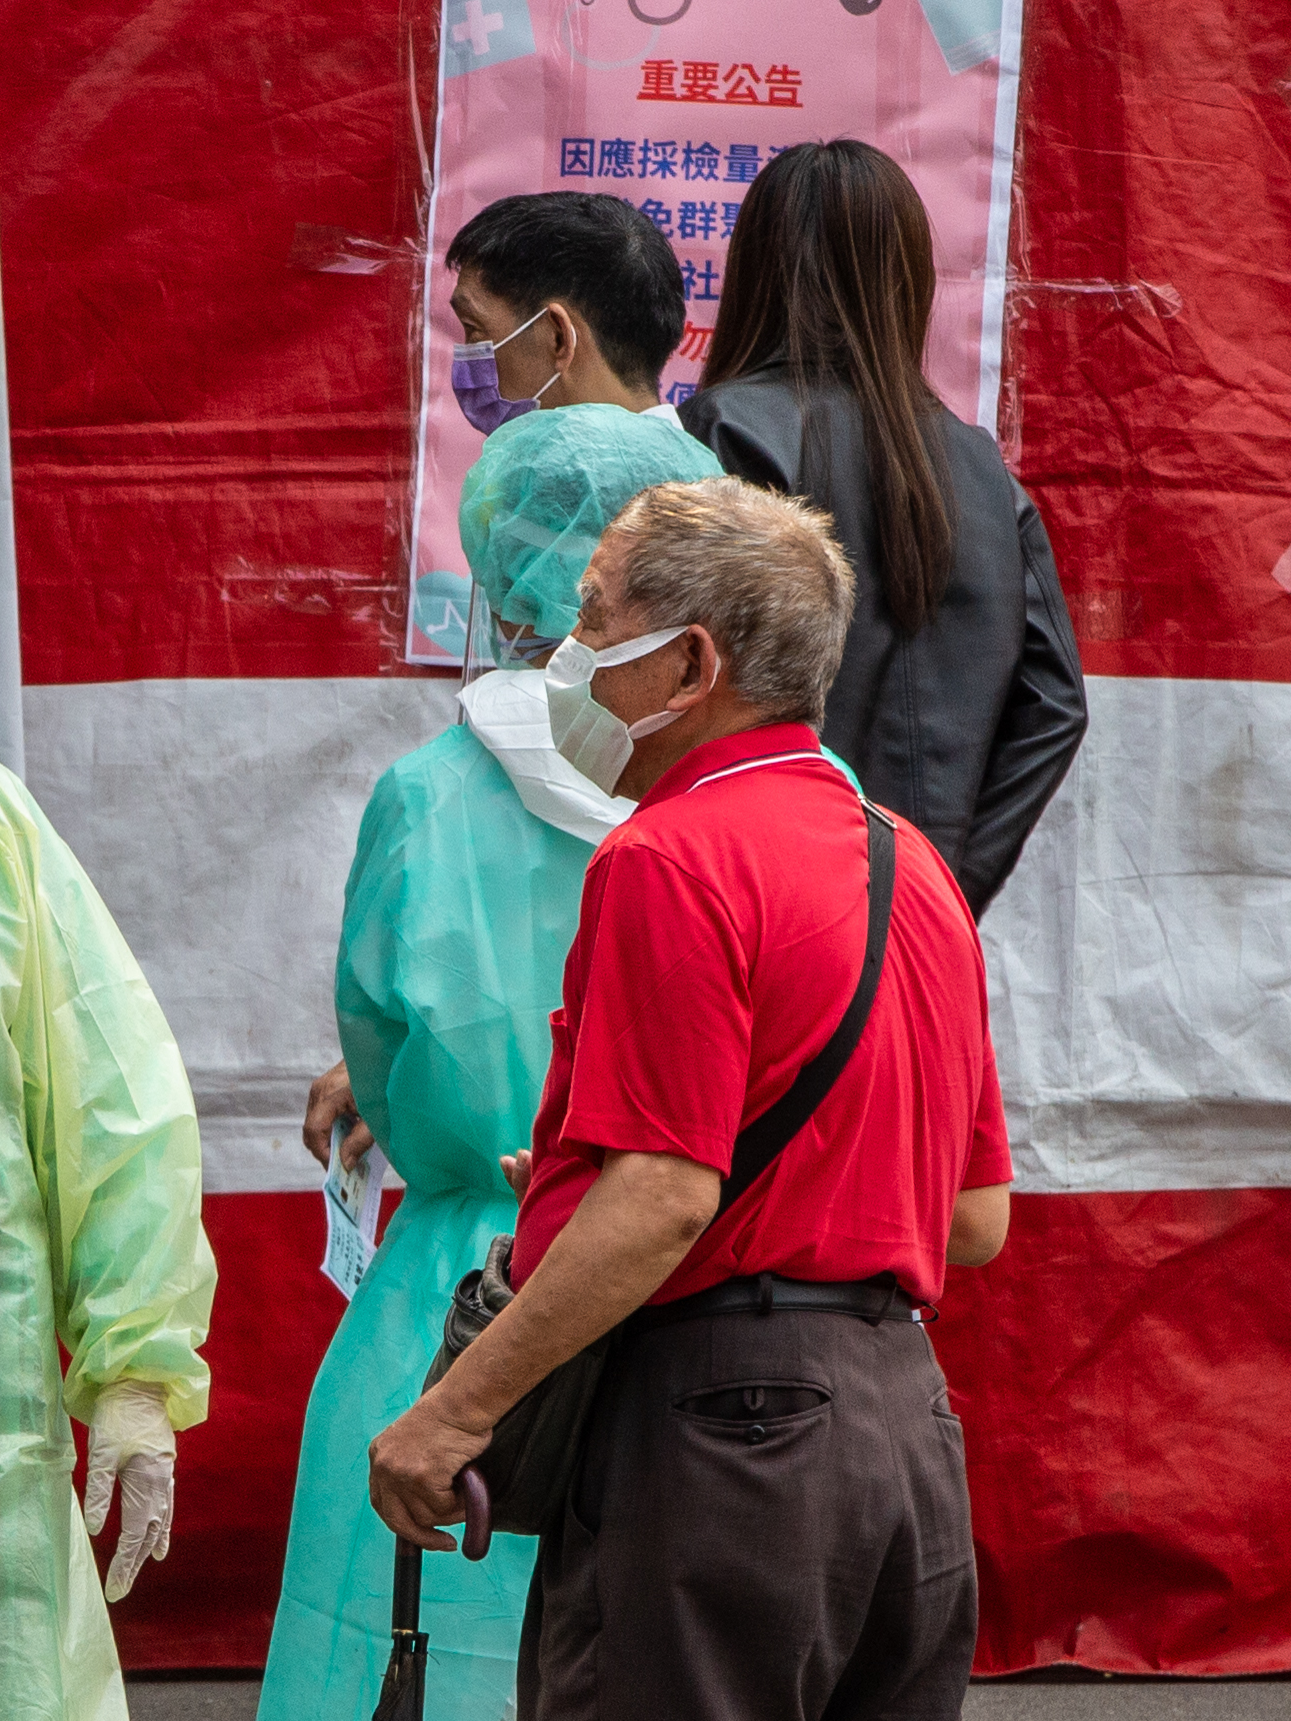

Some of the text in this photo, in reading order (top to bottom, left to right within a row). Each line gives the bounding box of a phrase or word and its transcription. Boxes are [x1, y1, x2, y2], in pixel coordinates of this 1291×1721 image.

[637, 60, 803, 105] 重要公告
[560, 136, 791, 184] 因應採檢量
[623, 198, 743, 240] 免群
